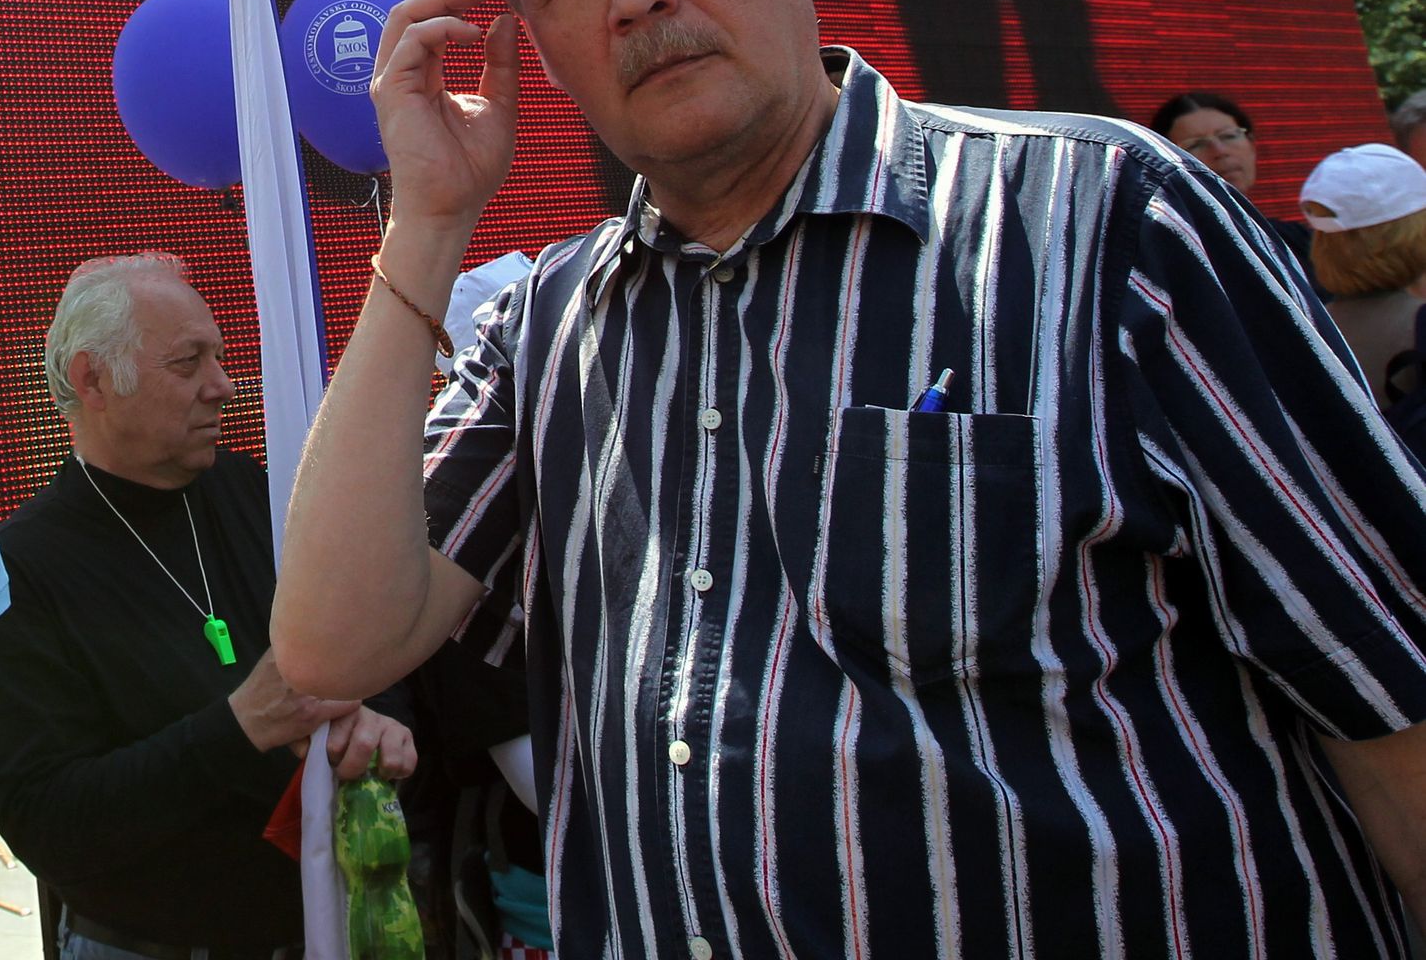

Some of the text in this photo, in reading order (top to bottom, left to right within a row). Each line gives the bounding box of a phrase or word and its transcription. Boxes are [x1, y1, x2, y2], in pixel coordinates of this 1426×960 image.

[350, 1, 388, 23] ODBOR
[336, 40, 368, 55] ČMOS
[334, 80, 370, 93] ŠKOLST
